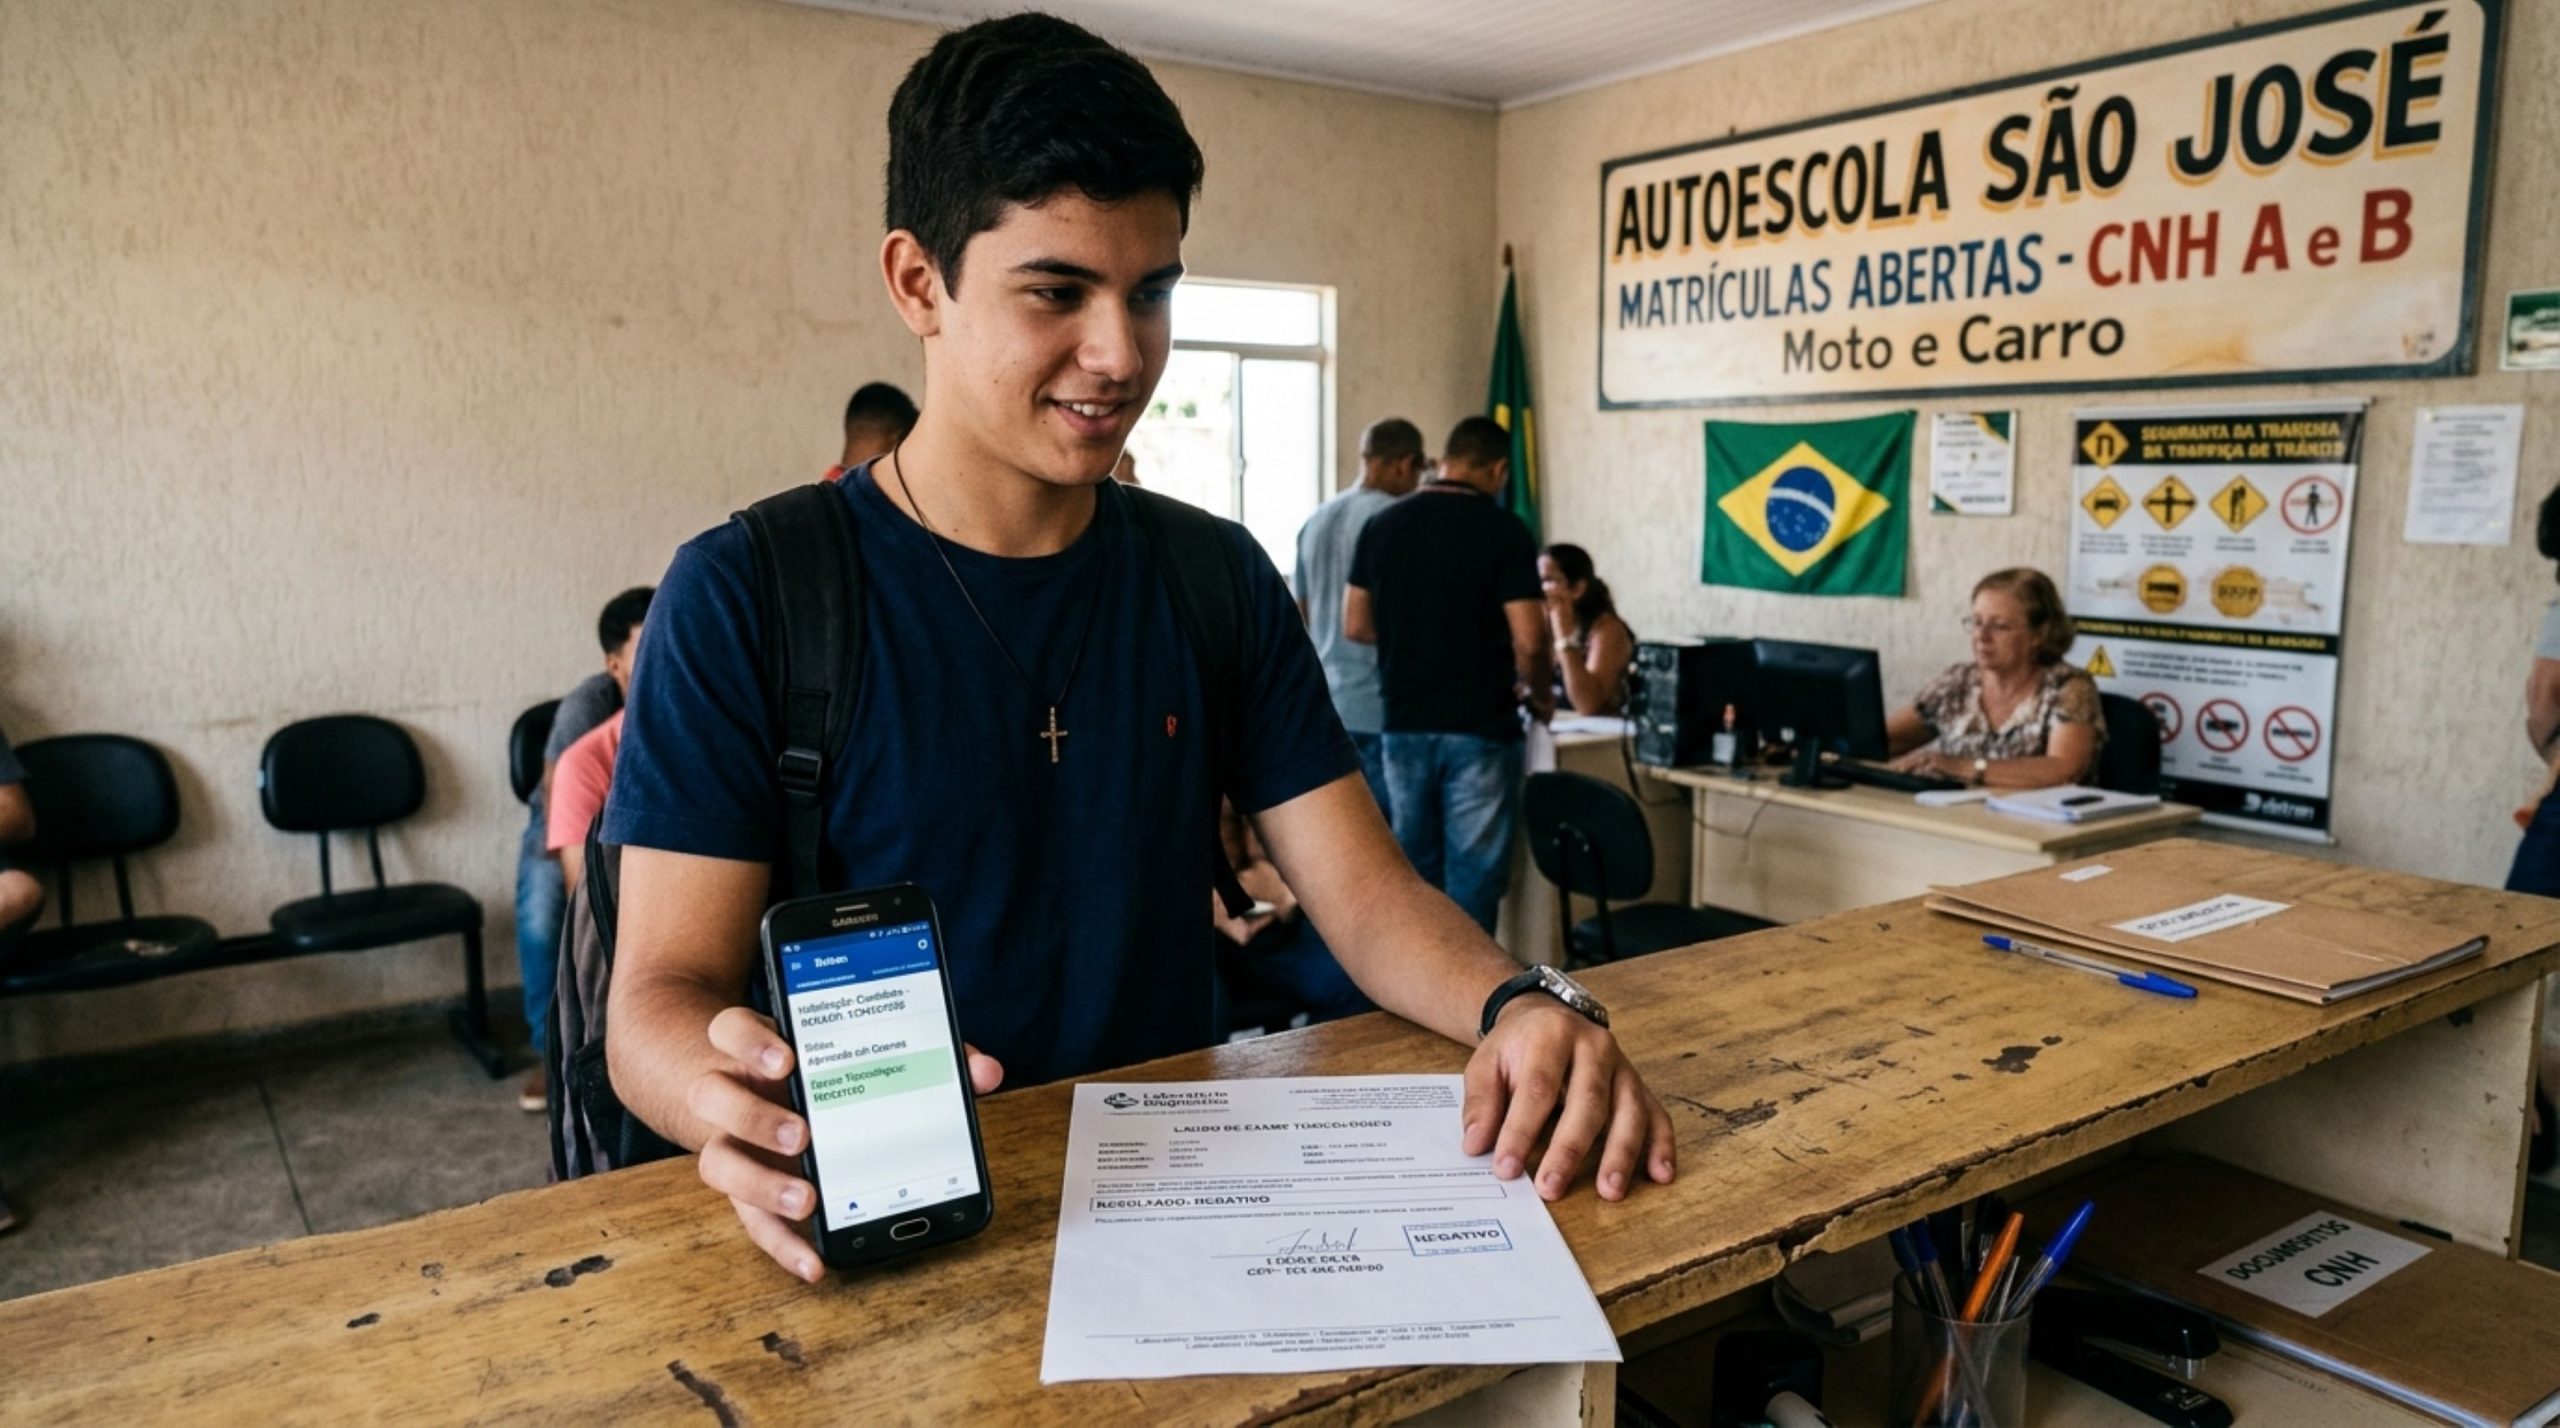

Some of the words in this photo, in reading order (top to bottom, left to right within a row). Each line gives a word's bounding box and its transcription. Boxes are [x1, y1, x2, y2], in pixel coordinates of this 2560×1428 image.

[1613, 129, 1950, 258] AUTOESCOLA
[1984, 84, 2137, 206] SÃO
[2171, 9, 2450, 178] JOSÉ
[1619, 261, 1831, 329] MATRÍCULAS
[1849, 233, 2043, 310] ABERTAS
[2087, 211, 2220, 288] CNH
[2242, 203, 2289, 274] A
[2307, 224, 2341, 267] e
[2359, 187, 2414, 264] B
[1782, 327, 1893, 375] Moto
[1911, 333, 1939, 367] e
[1958, 314, 2125, 364] Carro
[2303, 1250, 2381, 1287] CNH
